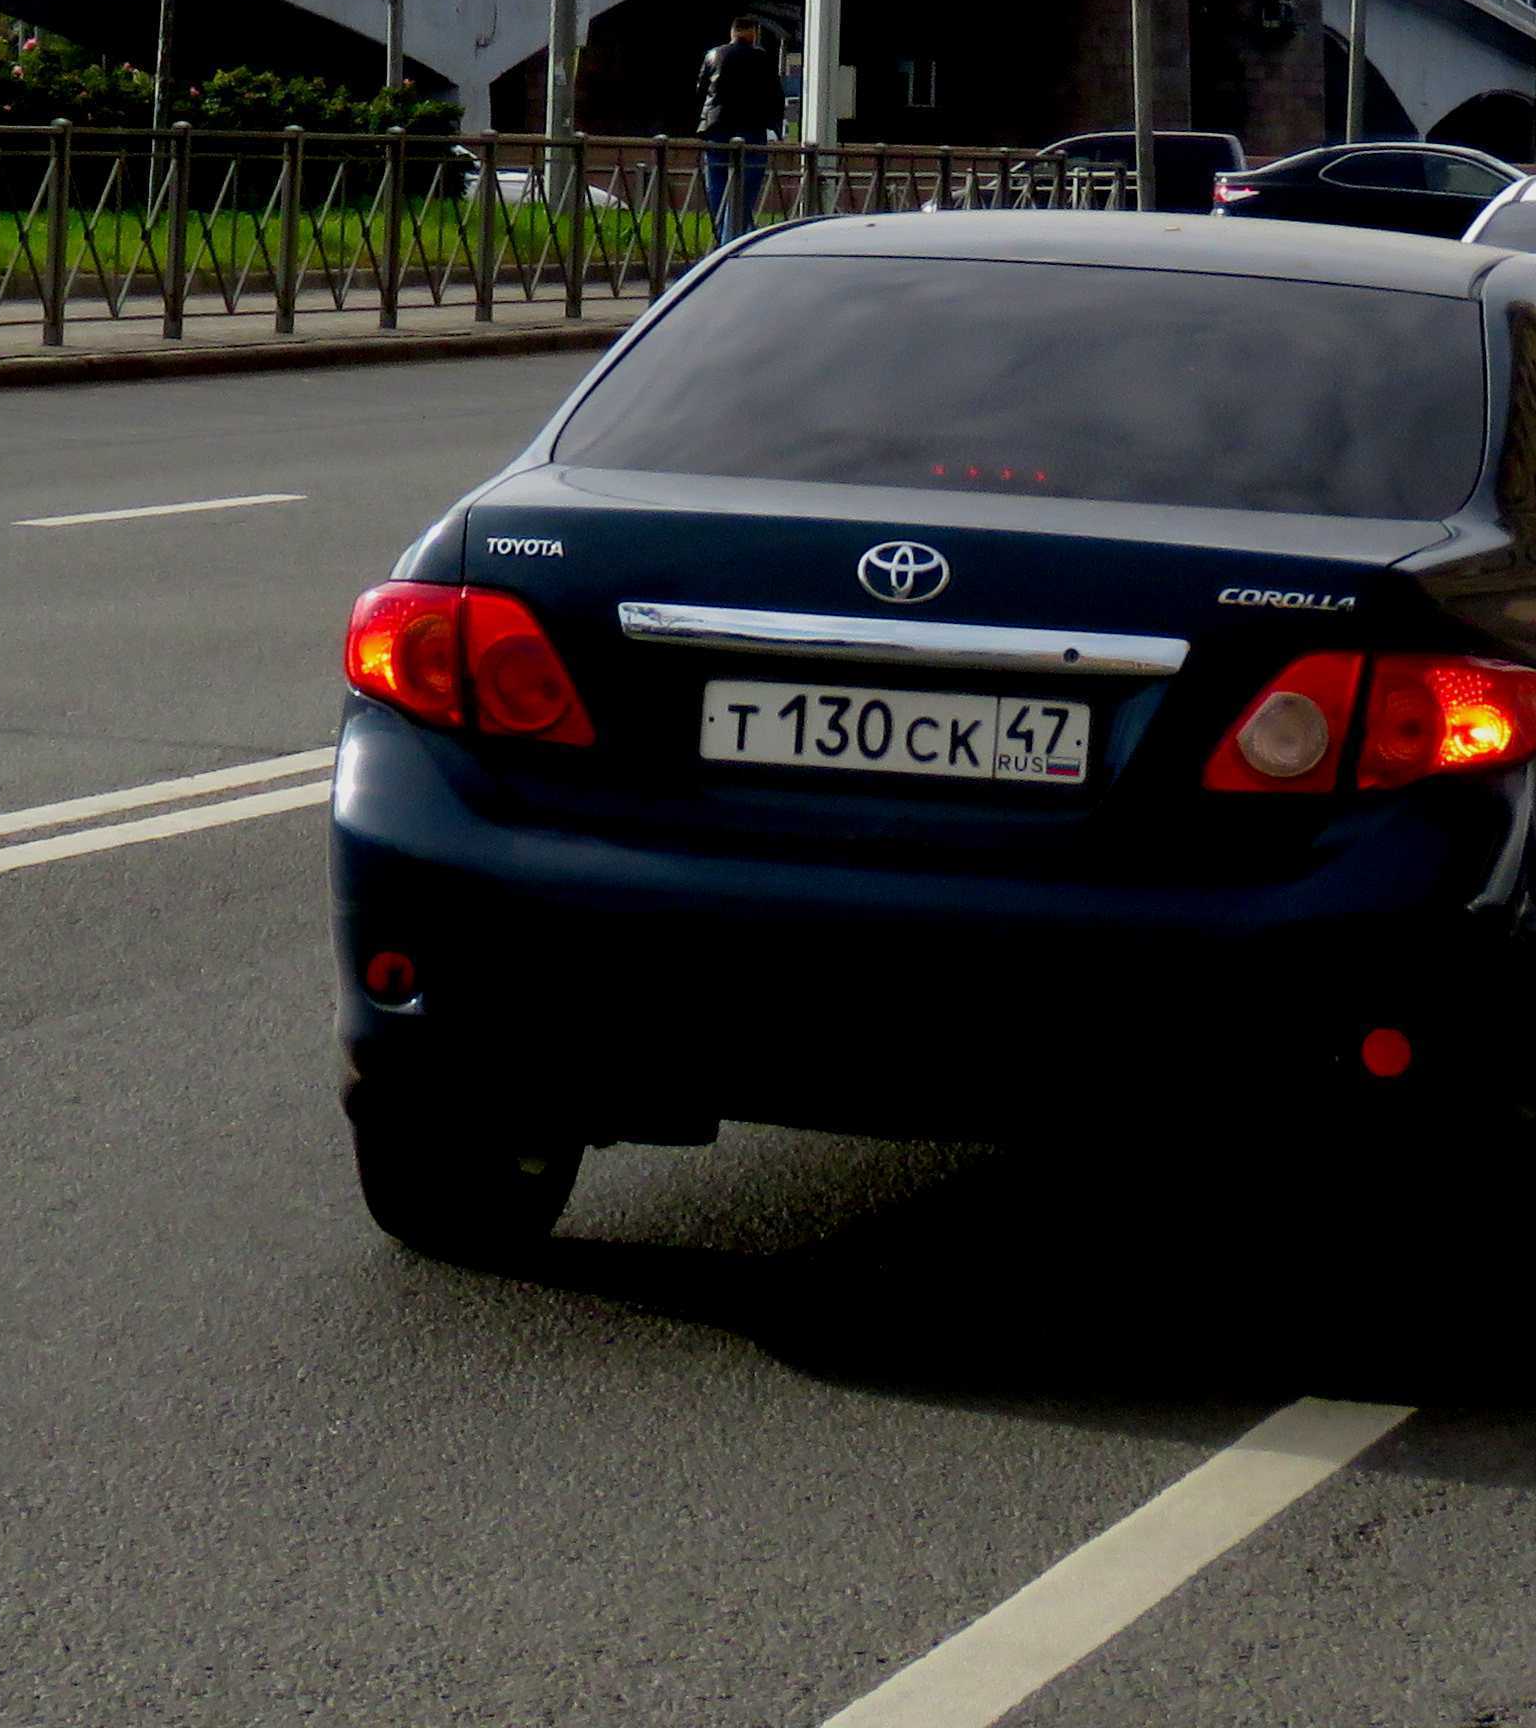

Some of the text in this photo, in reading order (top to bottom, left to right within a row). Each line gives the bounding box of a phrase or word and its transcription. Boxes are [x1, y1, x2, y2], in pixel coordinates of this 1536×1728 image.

[486, 537, 564, 557] TOYOTA
[1217, 588, 1357, 612] COROLLA
[1005, 705, 1070, 755] 47
[997, 754, 1045, 774] RUS
